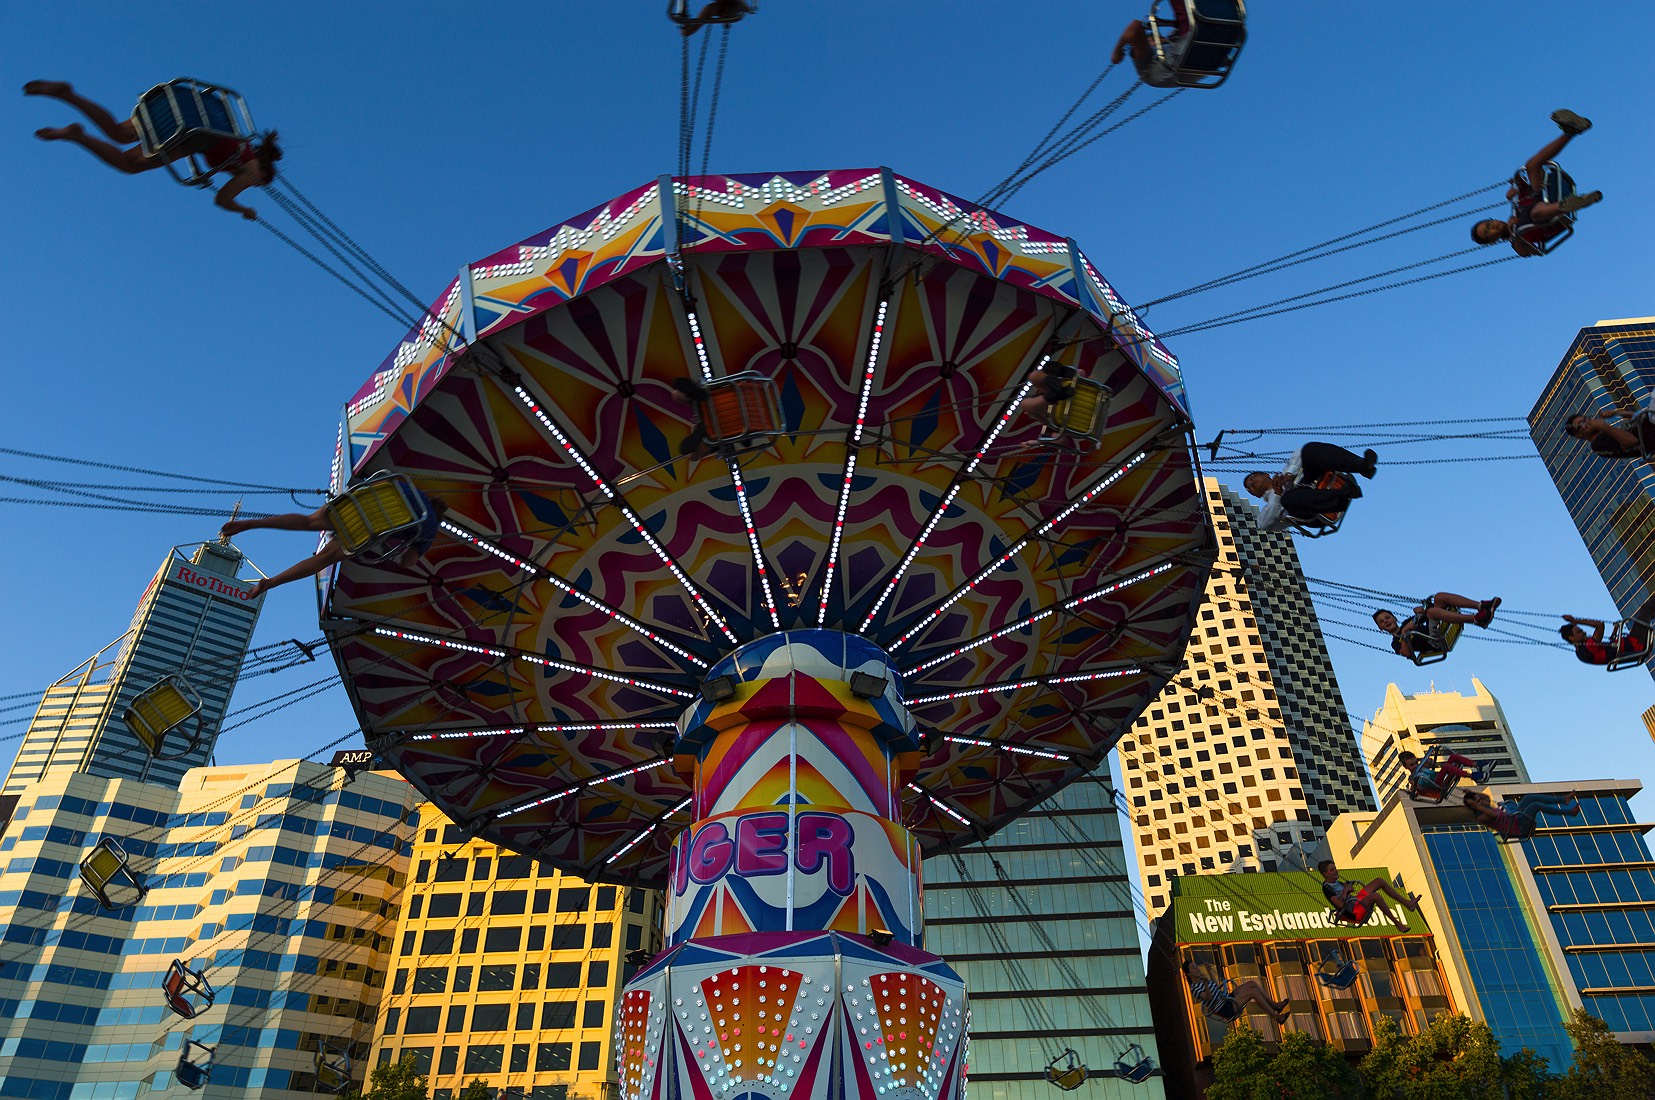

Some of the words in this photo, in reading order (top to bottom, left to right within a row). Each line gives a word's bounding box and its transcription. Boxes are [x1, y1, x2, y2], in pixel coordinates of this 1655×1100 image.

[339, 752, 372, 763] AMP
[1204, 899, 1231, 912] The
[1189, 912, 1234, 934] New
[1355, 904, 1408, 927] otel
